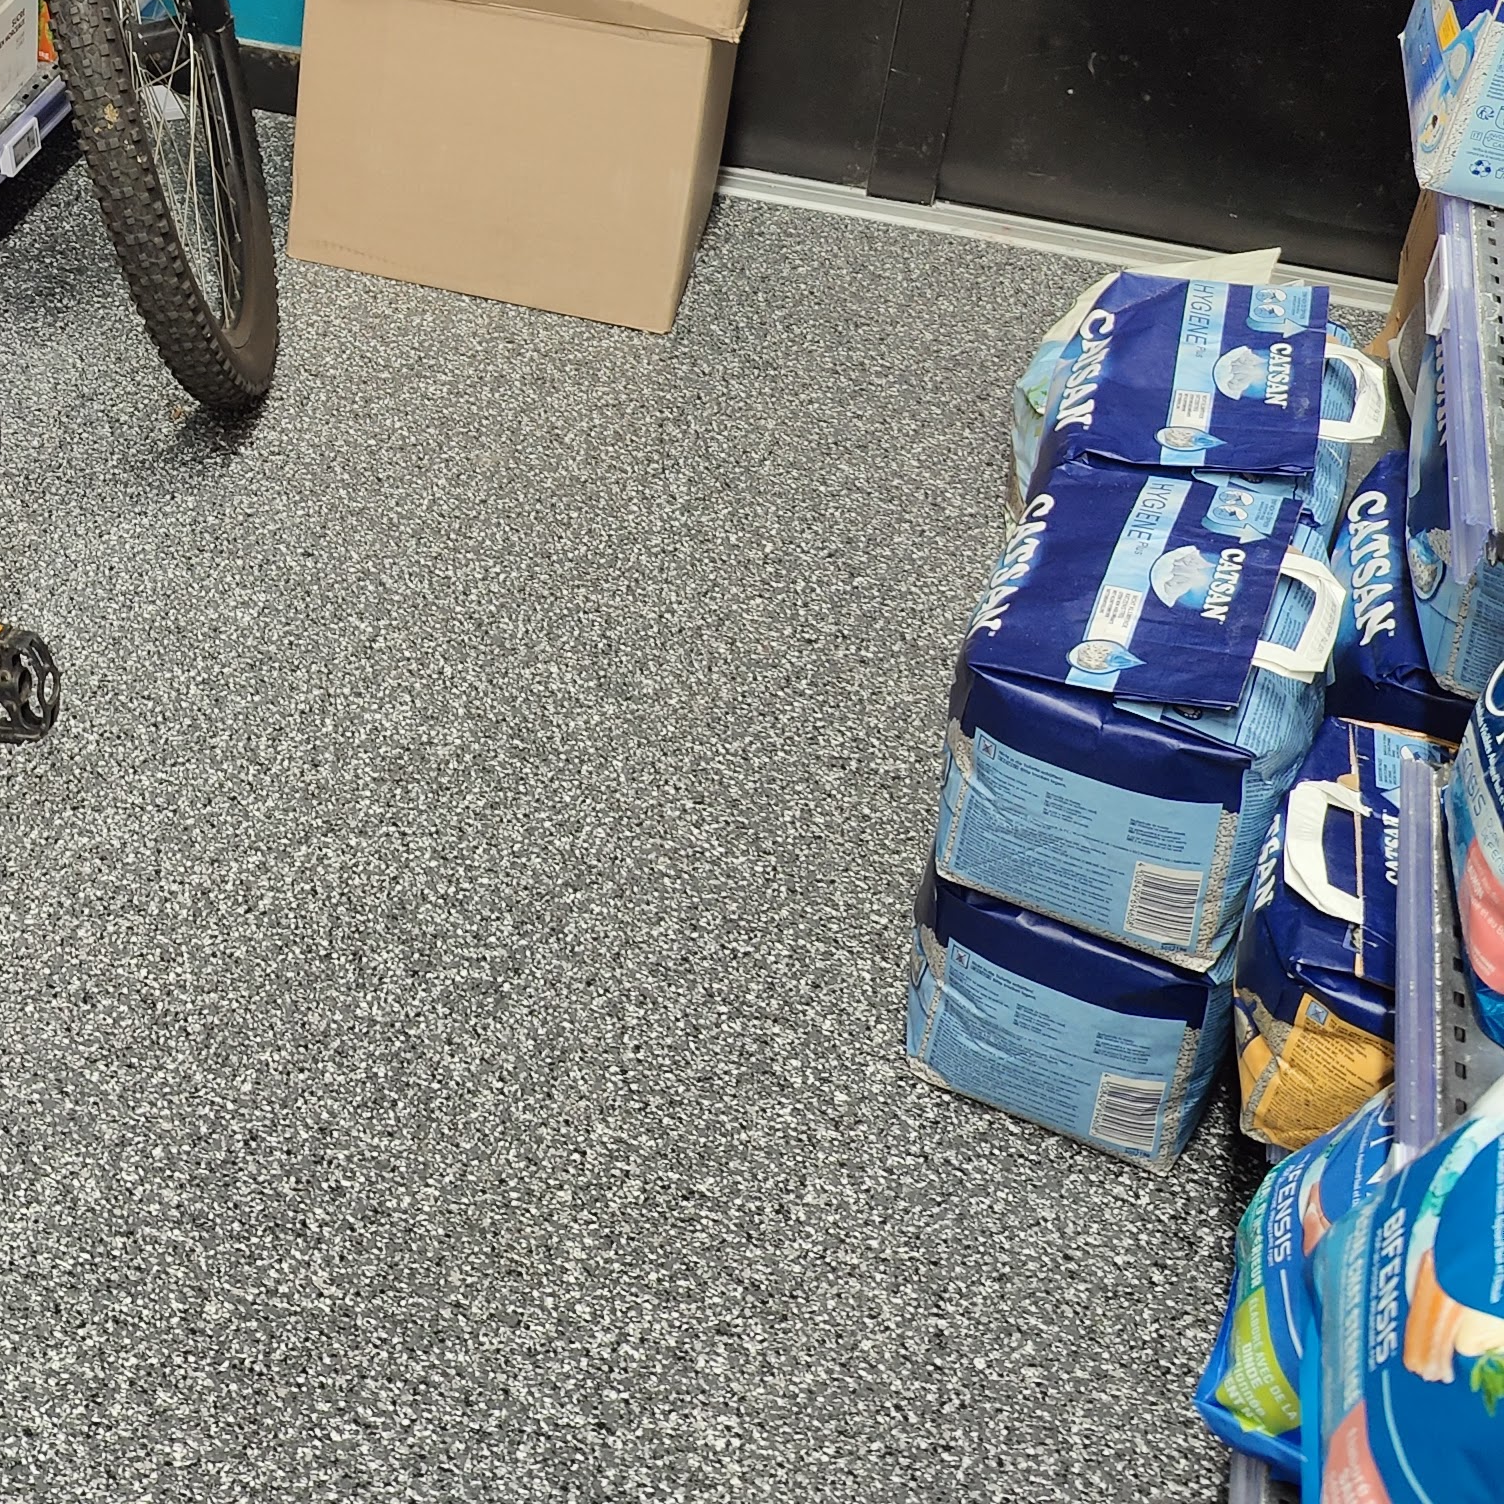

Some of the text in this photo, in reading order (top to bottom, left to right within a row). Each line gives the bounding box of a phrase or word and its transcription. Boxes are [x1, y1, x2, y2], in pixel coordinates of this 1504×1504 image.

[1186, 284, 1215, 347] HYGIENE
[1056, 309, 1115, 432] CATSAN
[1264, 342, 1294, 410] CATSAN
[1127, 482, 1175, 543] HYGIENE
[966, 493, 1054, 638] CATSAN
[1200, 547, 1247, 625] CATSAN
[1347, 489, 1396, 648] CATSAN
[1376, 1207, 1406, 1365] BIFENSIS
[1244, 1342, 1264, 1388] DINDE
[1257, 1352, 1274, 1385] AVEC
